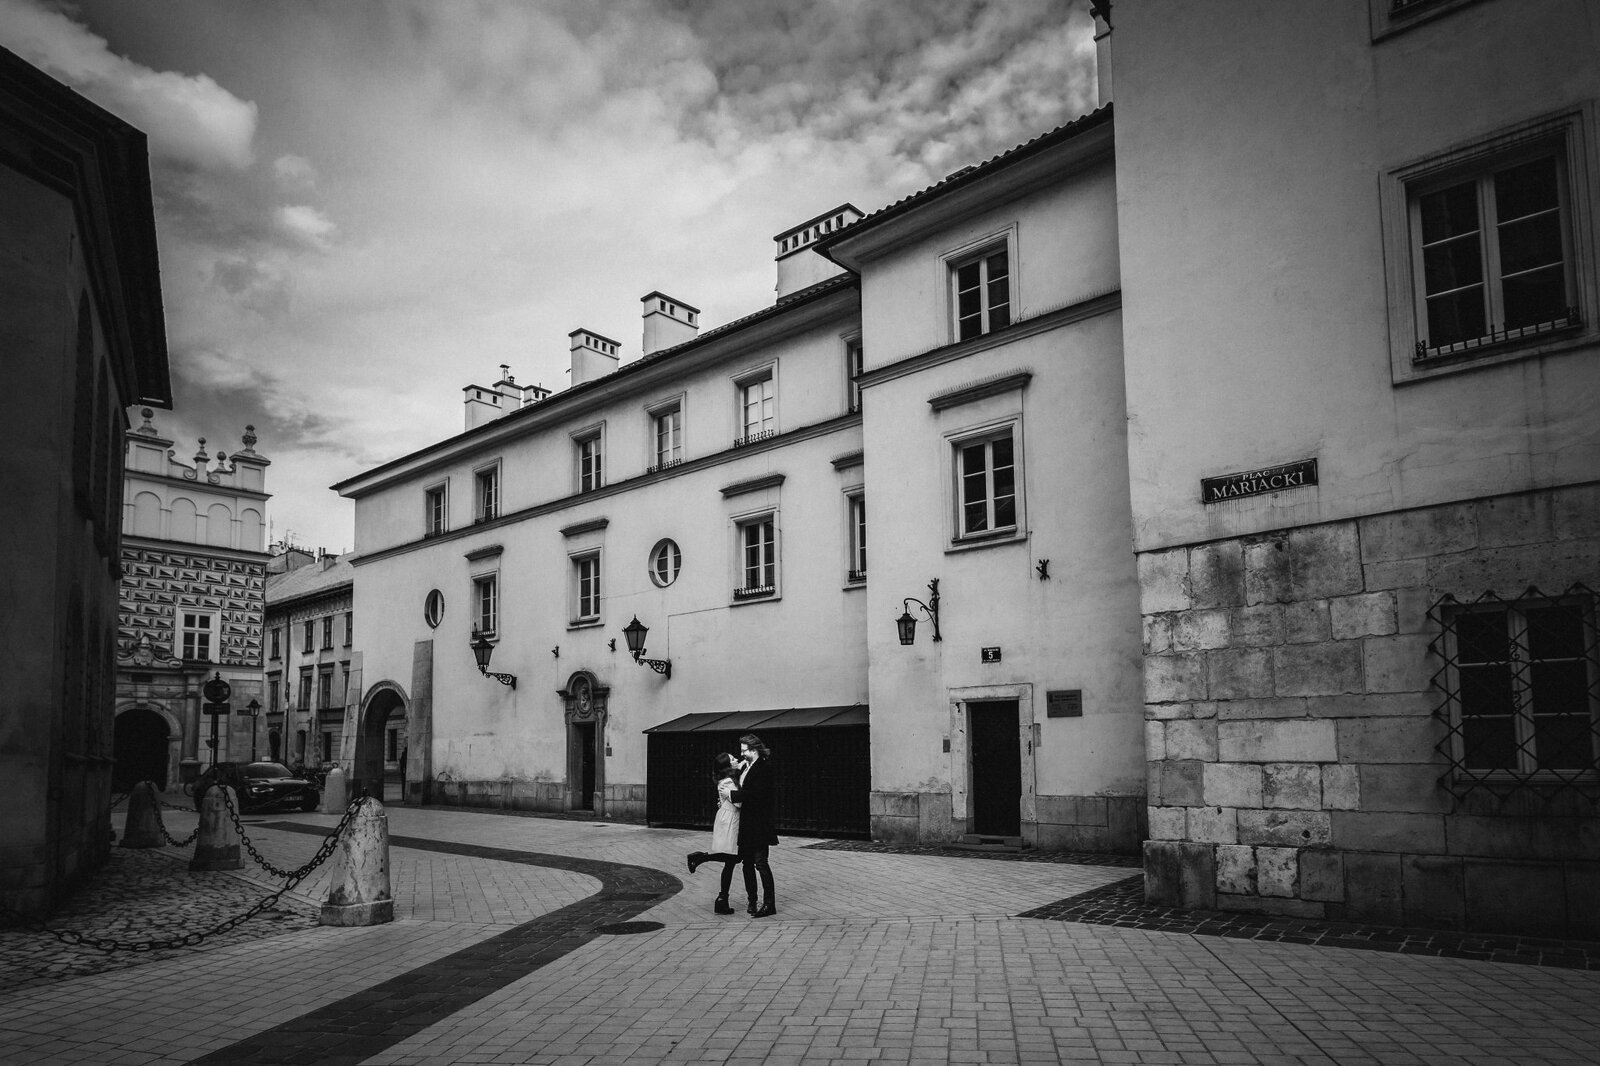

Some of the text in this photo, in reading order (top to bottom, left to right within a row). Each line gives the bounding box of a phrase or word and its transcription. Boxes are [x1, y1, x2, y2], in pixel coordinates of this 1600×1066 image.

[1242, 470, 1270, 480] PLAC
[1212, 471, 1305, 499] MARIACKI
[988, 651, 993, 659] 5
